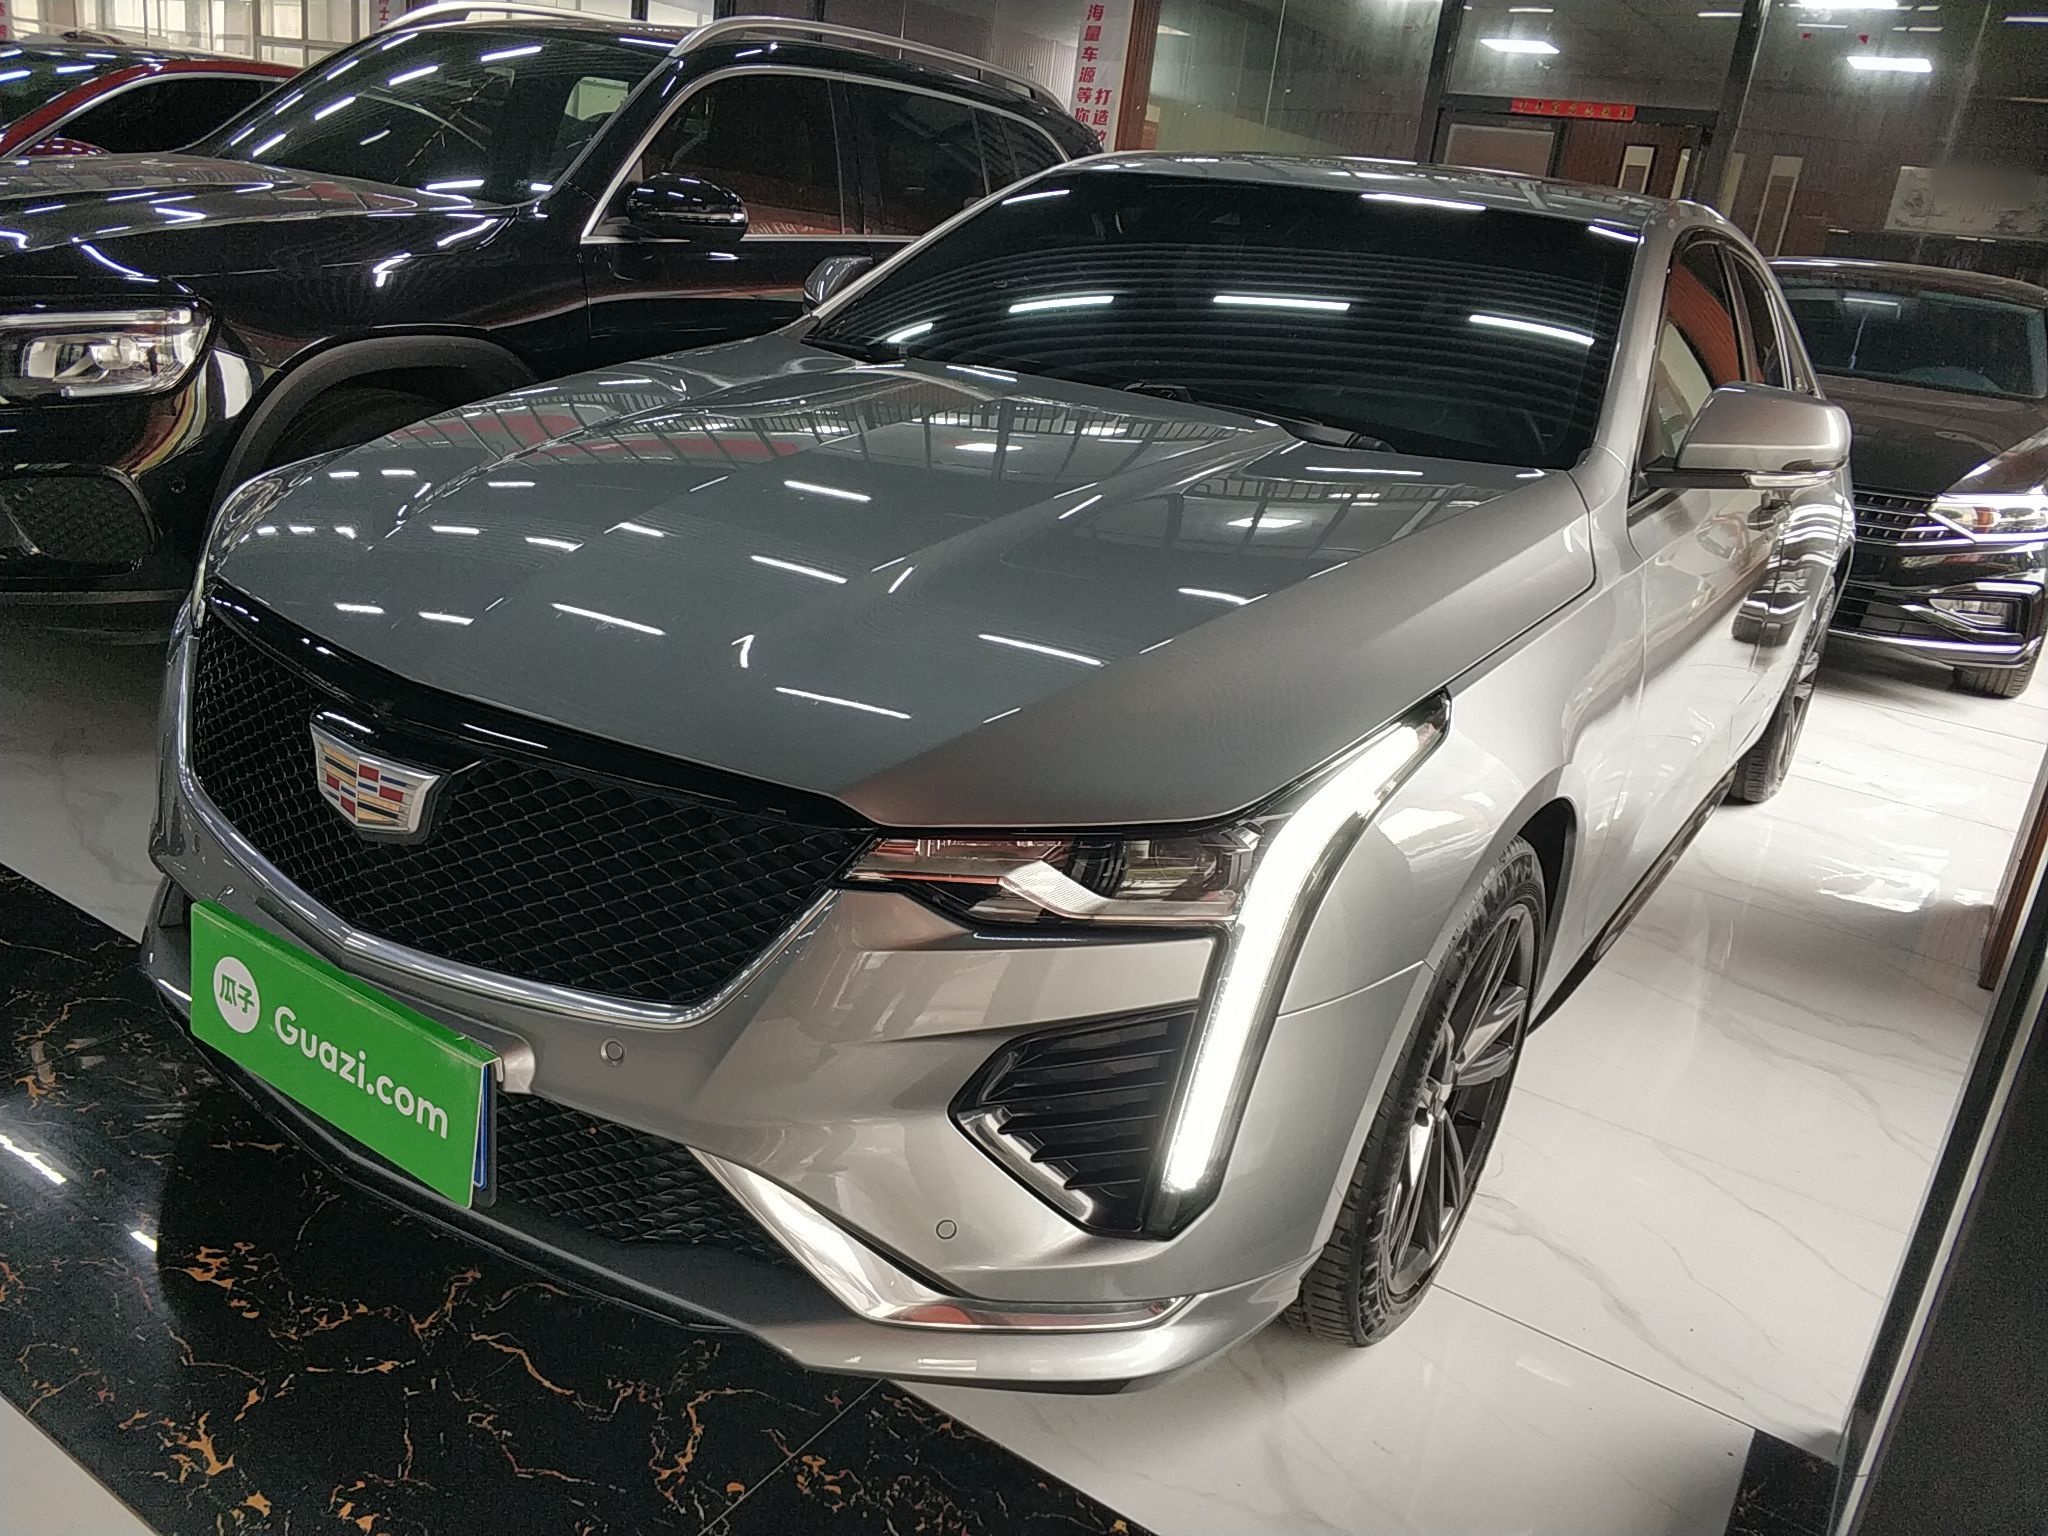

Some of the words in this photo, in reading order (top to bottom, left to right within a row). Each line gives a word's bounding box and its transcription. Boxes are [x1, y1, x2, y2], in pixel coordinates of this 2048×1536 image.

[1075, 4, 1105, 123] 海量车源等你
[219, 973, 255, 1013] 瓜子
[274, 1005, 449, 1140] Guazi.com
